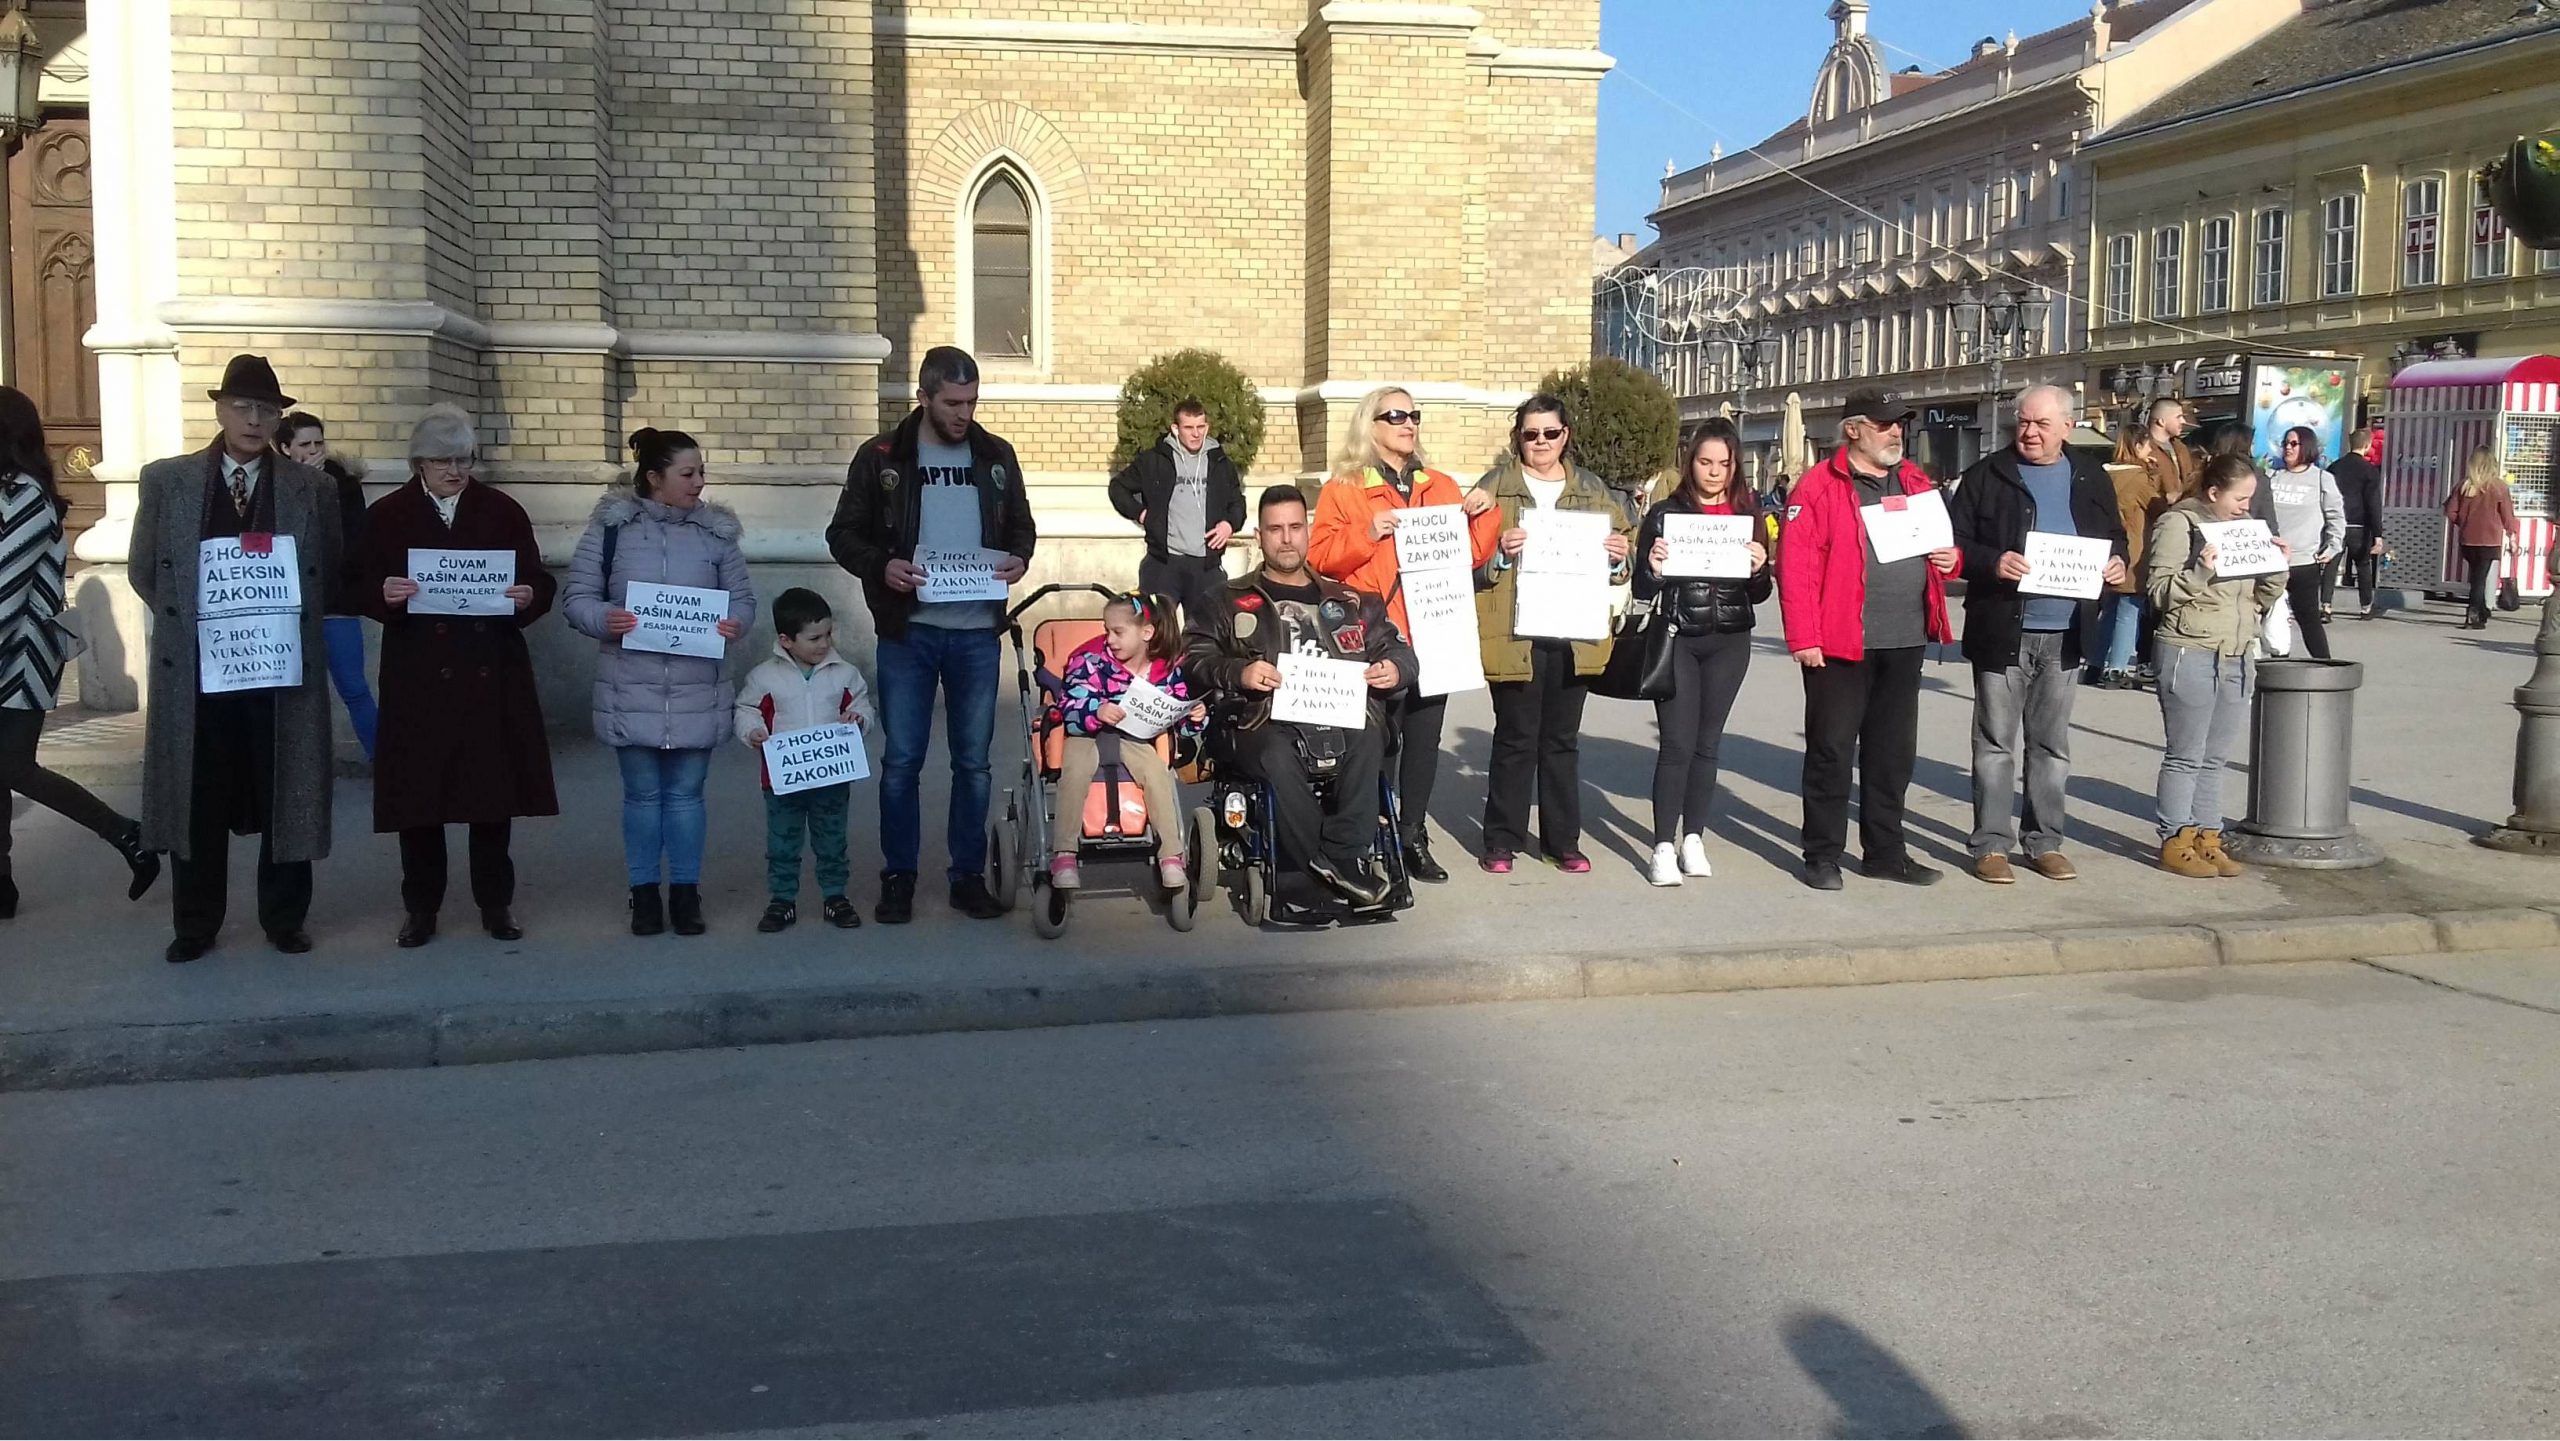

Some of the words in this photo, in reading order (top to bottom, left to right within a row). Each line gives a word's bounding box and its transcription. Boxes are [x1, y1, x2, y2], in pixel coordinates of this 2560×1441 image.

[2196, 370, 2241, 388] STING
[1405, 531, 1458, 545] ALEKSIN
[203, 550, 213, 564] 2
[439, 556, 487, 569] ČUVAM
[926, 551, 939, 561] 2
[206, 566, 286, 583] ALEKSIN
[416, 571, 457, 583] SAŠIN
[460, 572, 508, 583] ALARM
[932, 576, 990, 587] ZAKON!!!
[207, 586, 288, 604] ZAKON!!!
[428, 587, 465, 595] #SASHA
[655, 591, 701, 607] ČUVAM
[458, 598, 470, 610] 2
[633, 605, 672, 619] SAŠIN
[674, 609, 720, 623] ALARM
[213, 629, 225, 644] 2
[229, 625, 271, 641] HOĆU
[643, 622, 678, 632] #SASHA
[678, 625, 708, 635] ALERT
[670, 635, 682, 648] 2
[210, 642, 295, 660] VUKAŠINOV
[222, 660, 286, 676] ZAKON!!!
[1129, 697, 1164, 719] SAŠIN
[776, 740, 787, 751] 2
[788, 729, 834, 747] HOĆU
[781, 742, 851, 768] ALEKSIN
[783, 760, 856, 786] ZAKON!!!
